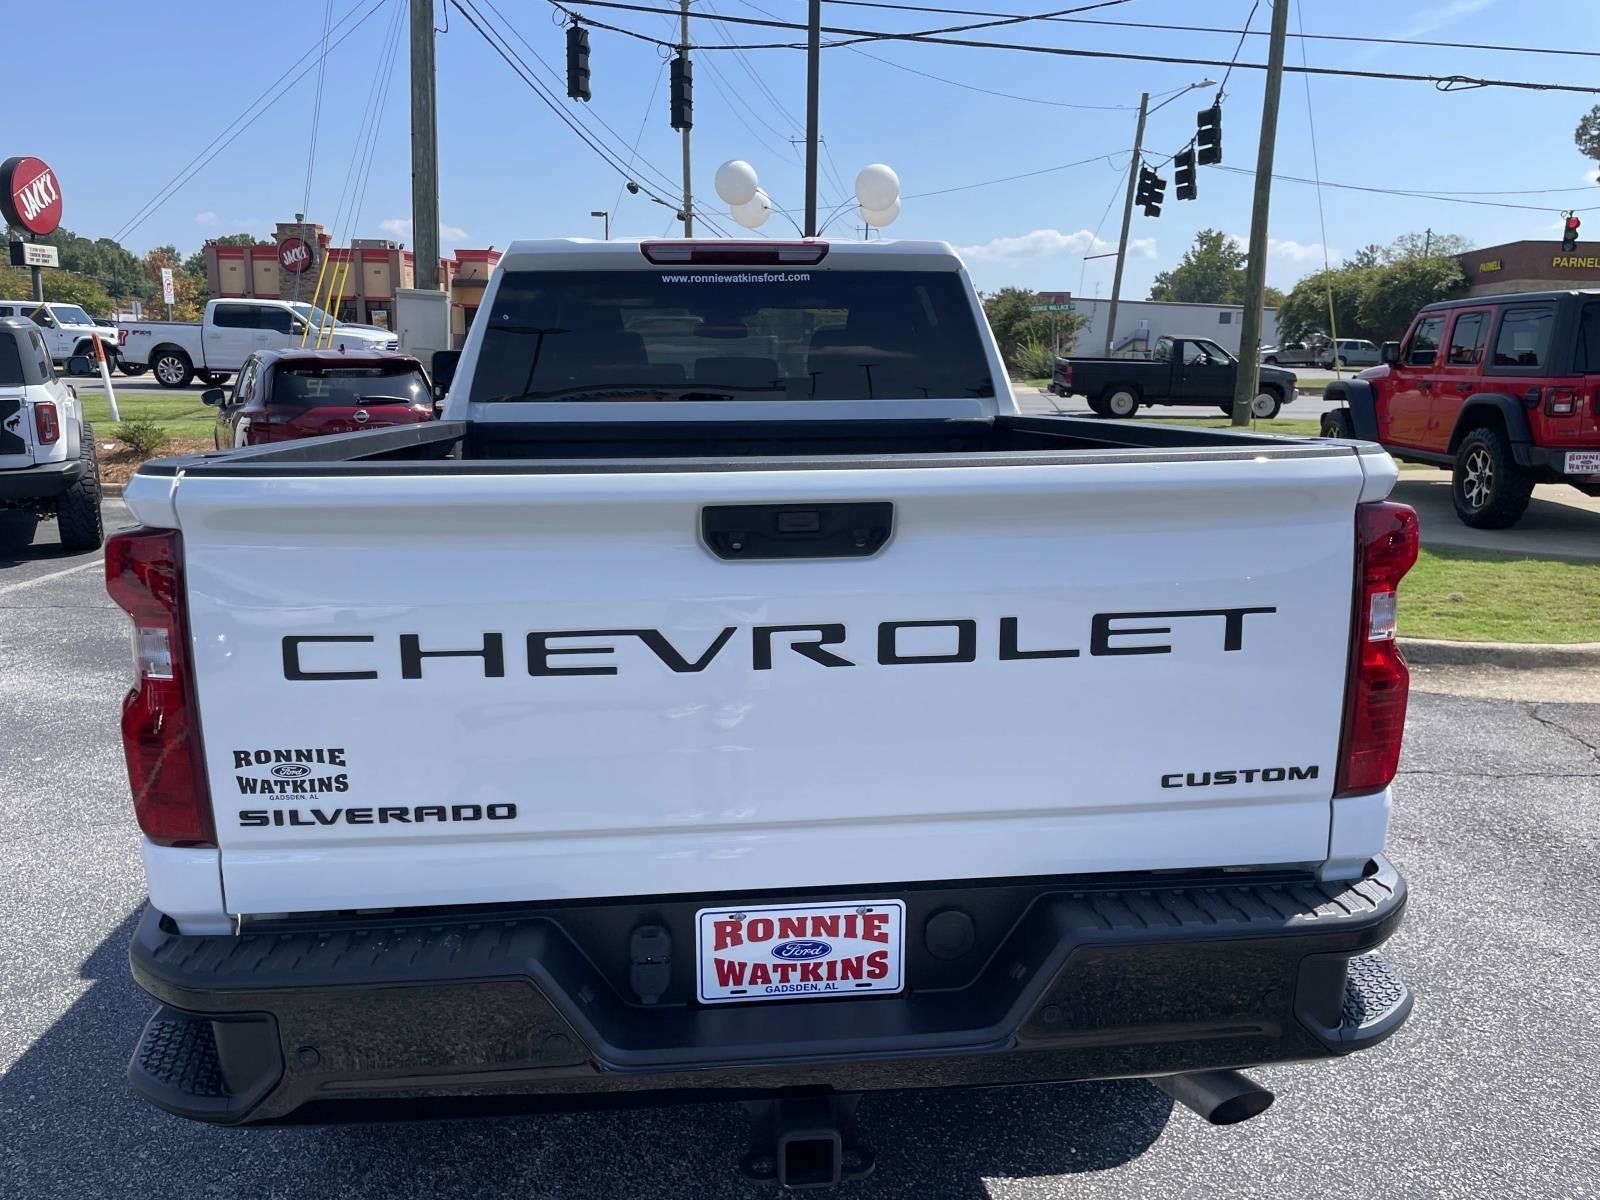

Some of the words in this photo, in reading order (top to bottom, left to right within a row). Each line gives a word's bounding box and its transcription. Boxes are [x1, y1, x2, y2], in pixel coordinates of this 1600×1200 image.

[20, 173, 56, 221] JACK'S
[661, 272, 811, 284] www.ronniewatkinsford.com
[282, 607, 1277, 681] CHEVROLET
[233, 748, 346, 769] RONNIE
[280, 766, 303, 776] Ford
[1161, 765, 1320, 789] CUSTOM
[236, 774, 349, 794] WATKINS
[238, 803, 518, 827] SILVERADO
[714, 913, 889, 951] RONNIE
[783, 943, 823, 956] Ford
[714, 950, 889, 987] WATKINS
[765, 984, 821, 994] GADSDEN,
[824, 983, 838, 991] AL
